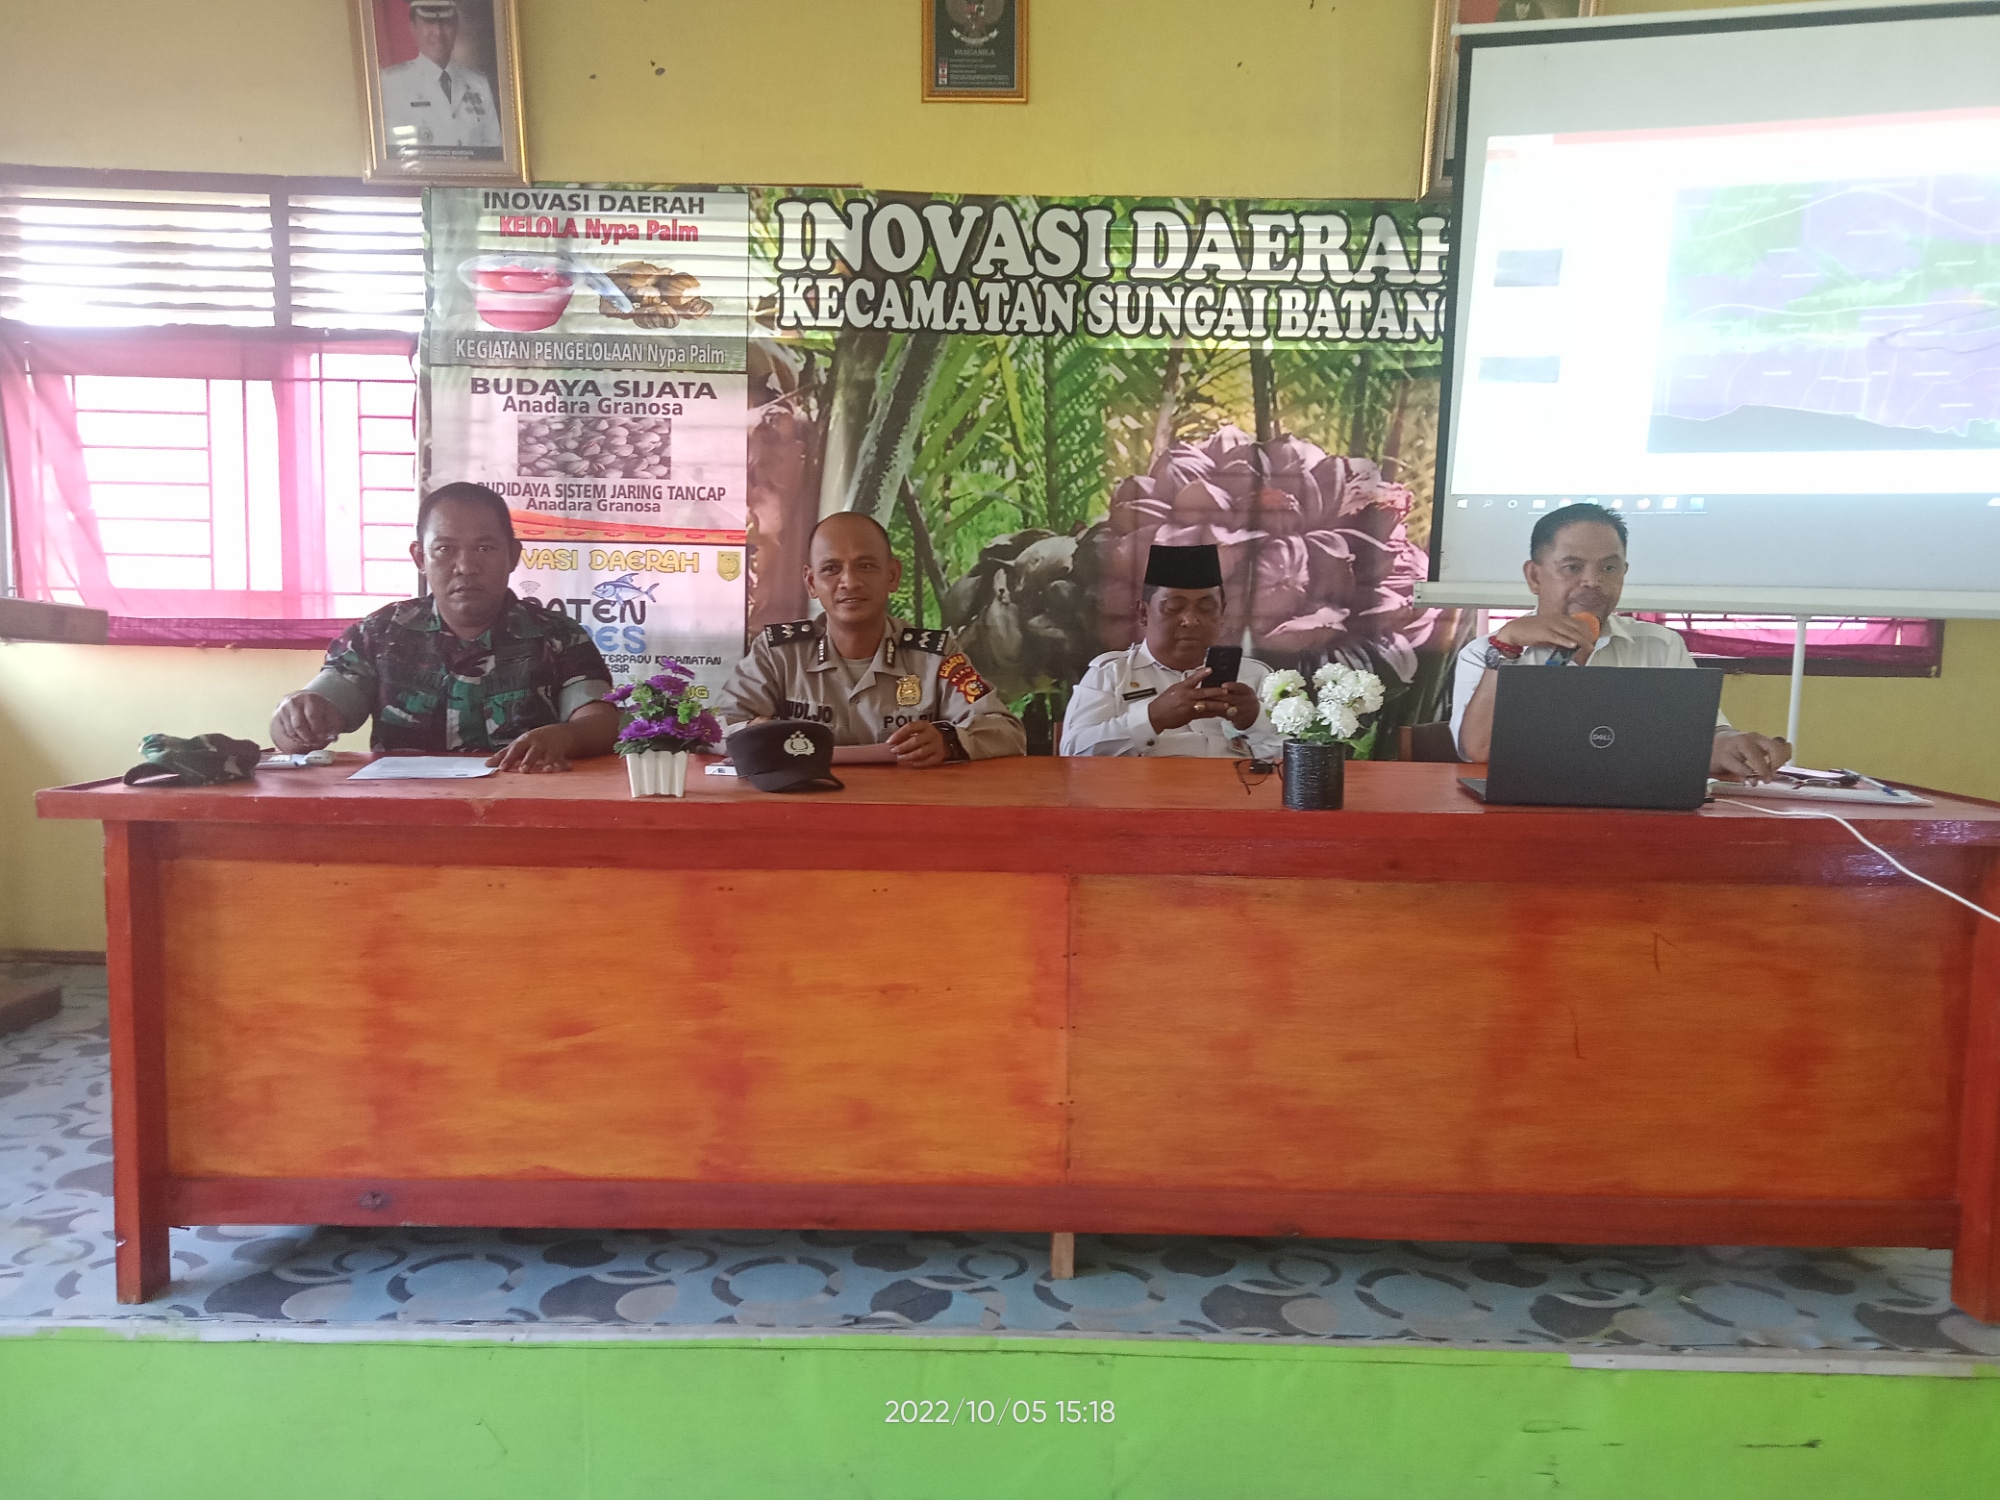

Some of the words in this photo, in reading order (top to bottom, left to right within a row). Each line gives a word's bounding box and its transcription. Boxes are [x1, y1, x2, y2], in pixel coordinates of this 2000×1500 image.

[483, 192, 589, 213] INOVASI
[599, 194, 705, 215] DAERAH
[500, 215, 579, 239] KELOLA
[585, 218, 639, 245] Nypa
[647, 219, 699, 242] Palm
[775, 201, 1114, 280] INOVASI
[778, 275, 1077, 336] KECAMATAN
[1085, 284, 1271, 339] SUNGAI
[1273, 288, 1446, 342] BATAN
[455, 339, 530, 360] KEGIATAN
[534, 340, 643, 363] PENGELOLAAN
[647, 344, 685, 367] Nypa
[690, 344, 725, 364] Palm
[470, 377, 603, 398] BUDAYA
[613, 380, 717, 400] SIJATA
[503, 396, 590, 414] Anadara
[597, 398, 684, 416] Granosa
[477, 482, 551, 498] UDIDAYA
[555, 484, 606, 499] SISTEM
[610, 485, 663, 501] JARING
[667, 486, 726, 502] TANCAP
[526, 498, 593, 512] Anadara
[597, 499, 661, 514] Granosa
[520, 548, 579, 571] VASI
[590, 550, 700, 573] DAERAH
[522, 596, 647, 625] ATEN
[581, 624, 647, 654] ES
[600, 653, 652, 665] TERPADU
